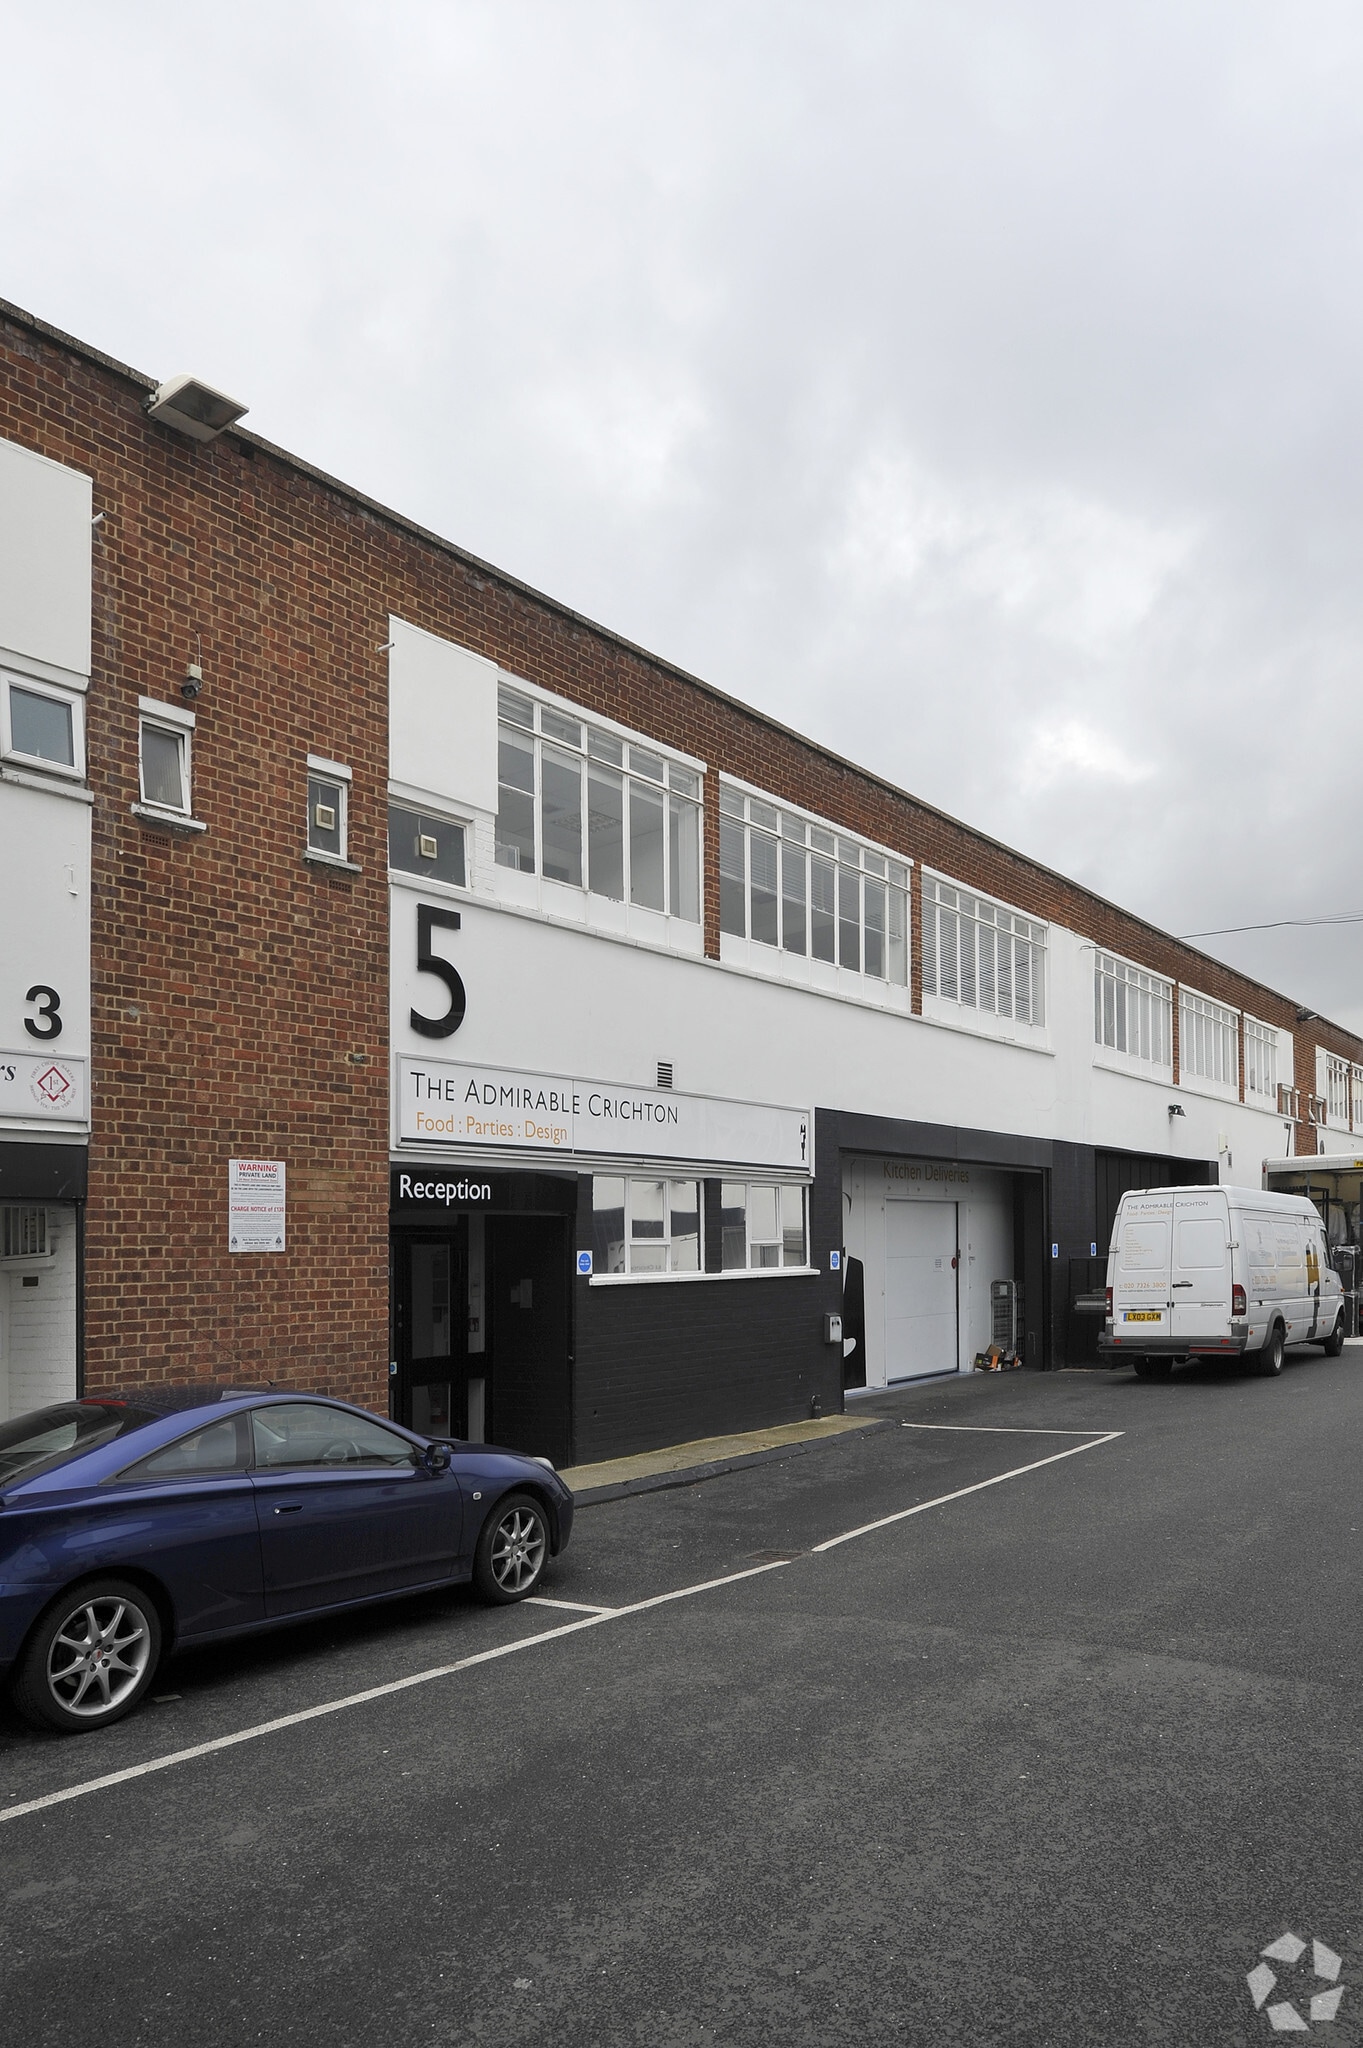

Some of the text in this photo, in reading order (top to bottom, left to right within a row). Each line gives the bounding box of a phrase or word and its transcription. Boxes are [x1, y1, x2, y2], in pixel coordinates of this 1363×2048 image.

[410, 903, 466, 1039] 5
[24, 985, 62, 1040] 3
[410, 1072, 678, 1124] THE ADMIRABLE CRICHTON
[416, 1112, 454, 1133] Food
[466, 1116, 514, 1137] Parties
[525, 1120, 568, 1144] Design
[238, 1163, 278, 1172] WARNING
[883, 1161, 969, 1183] Kitchen Deliveries
[400, 1174, 491, 1206] Reception
